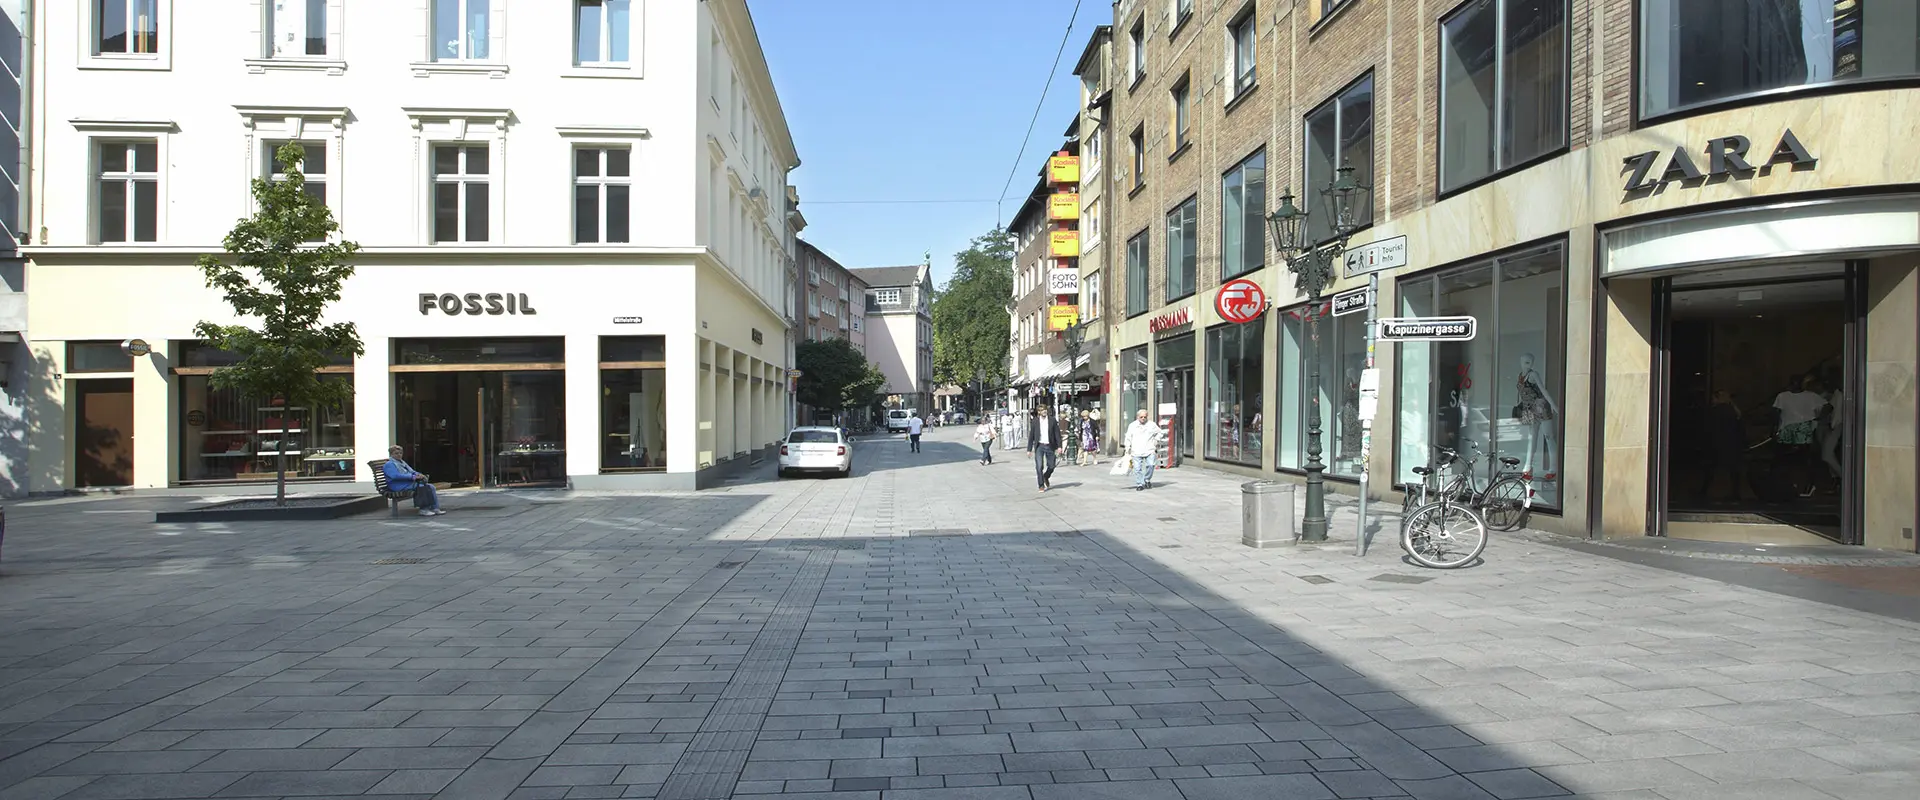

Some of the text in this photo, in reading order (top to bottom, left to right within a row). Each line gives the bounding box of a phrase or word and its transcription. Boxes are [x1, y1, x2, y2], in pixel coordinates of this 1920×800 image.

[1620, 127, 1819, 198] ZARA
[1382, 244, 1402, 253] Tourist
[1052, 273, 1078, 281] FOTO
[1052, 281, 1078, 289] SÖHN
[418, 292, 538, 317] FOSSIL
[1350, 294, 1364, 306] Straße
[1150, 306, 1188, 333] ROSSMANN
[1388, 324, 1465, 336] Kapuzinergasse
